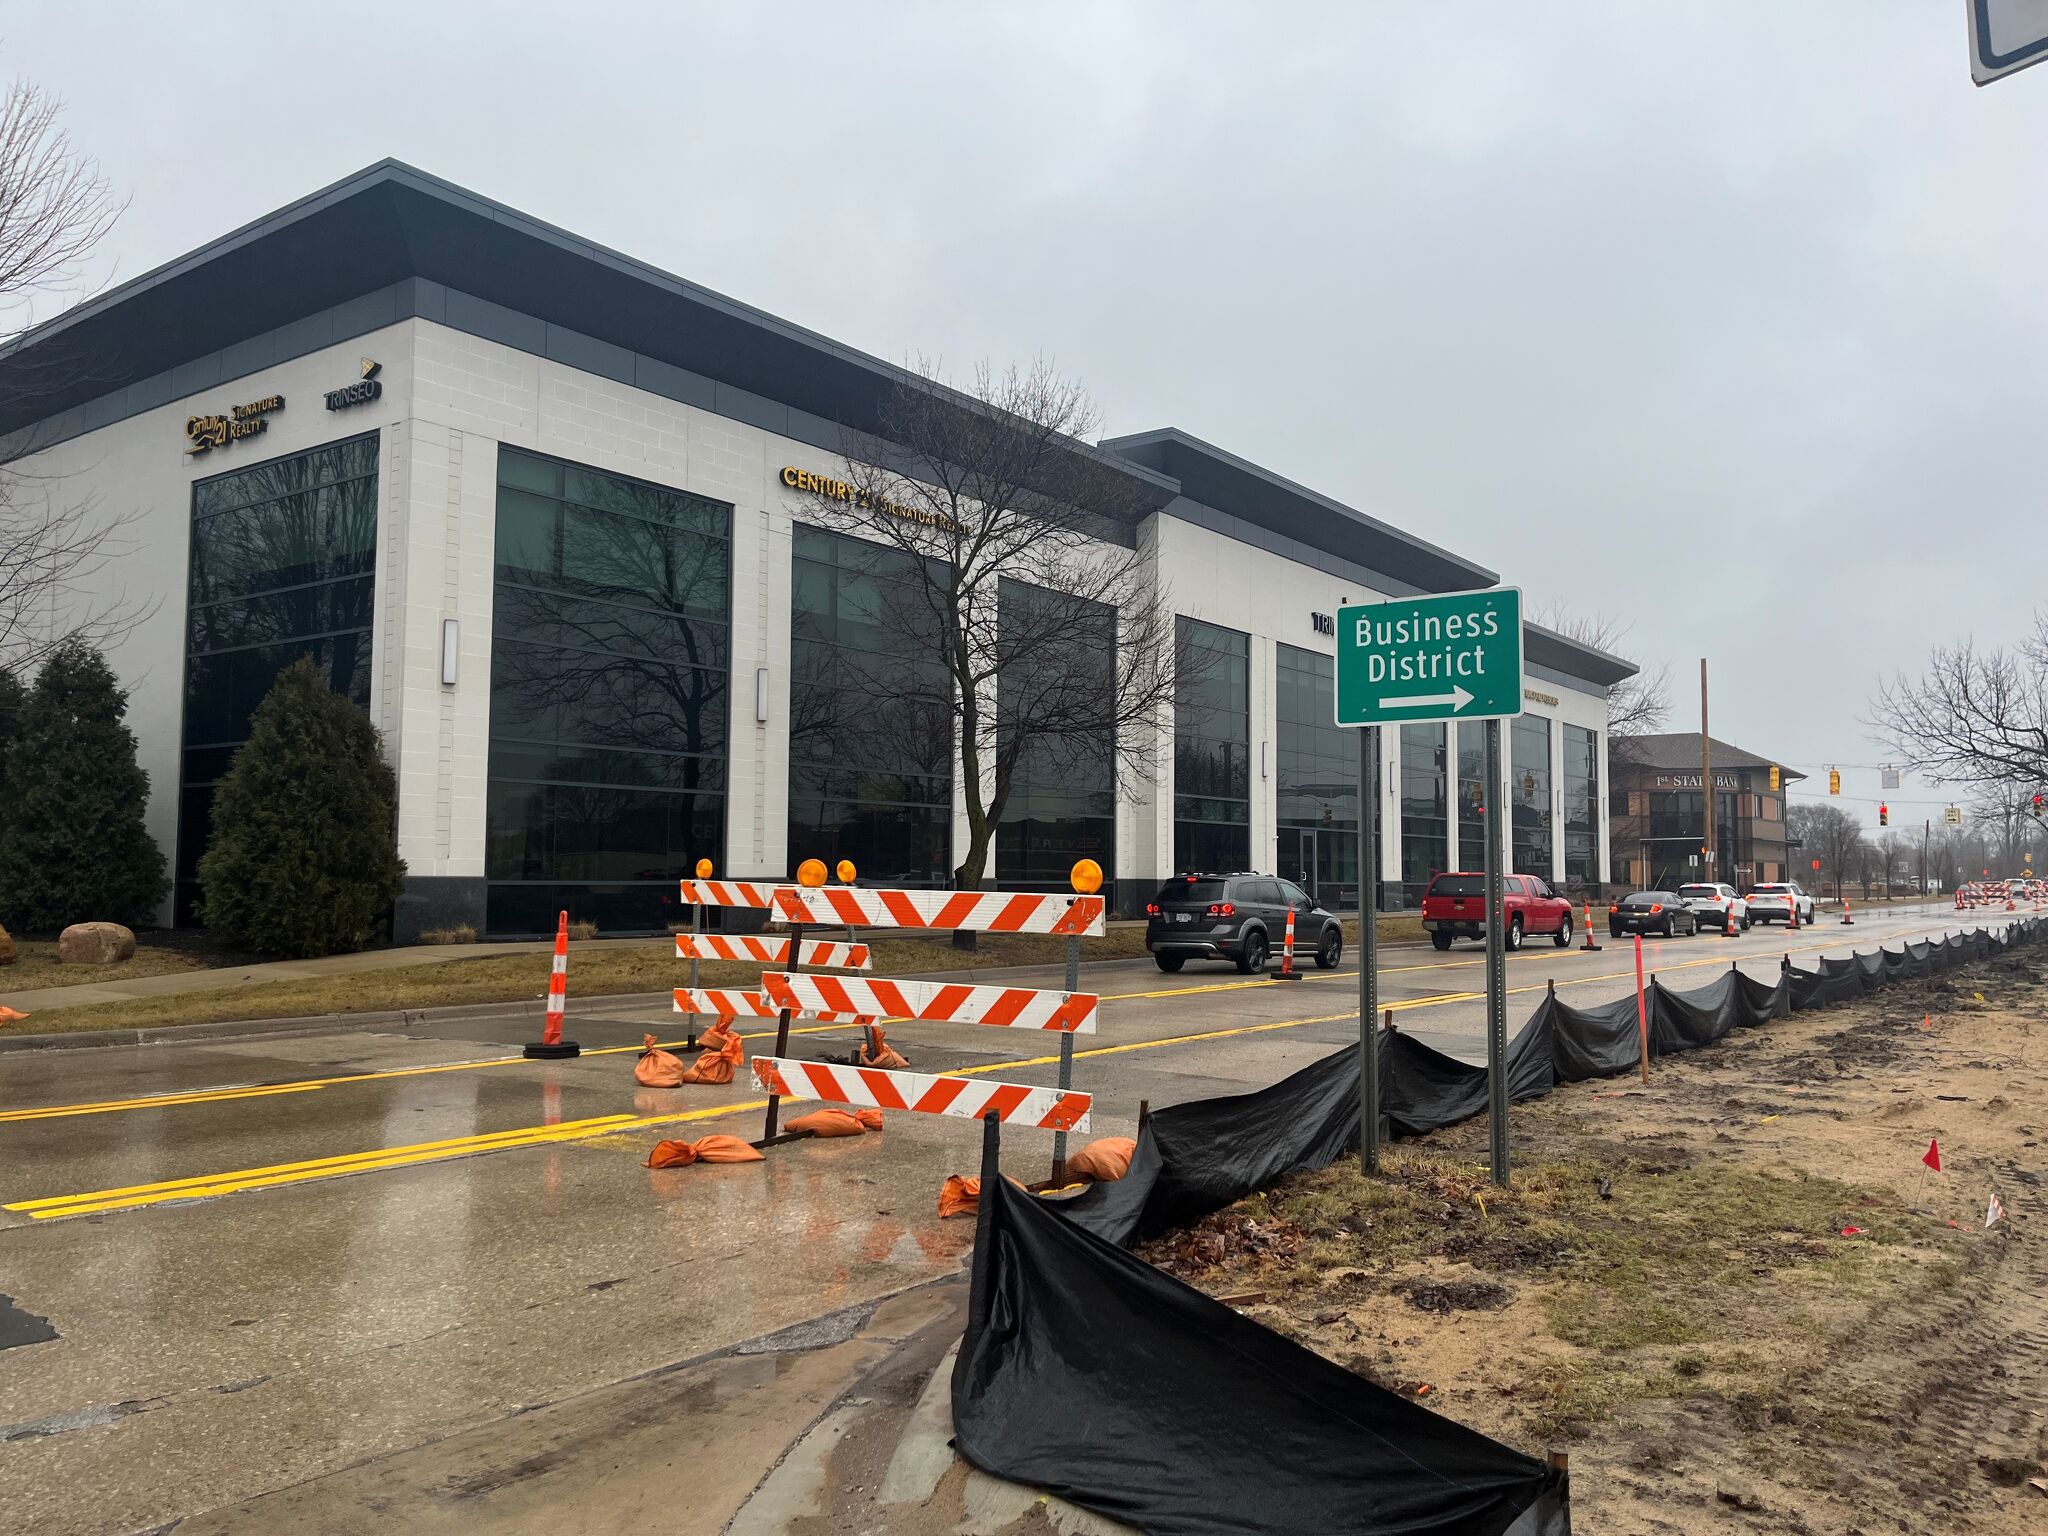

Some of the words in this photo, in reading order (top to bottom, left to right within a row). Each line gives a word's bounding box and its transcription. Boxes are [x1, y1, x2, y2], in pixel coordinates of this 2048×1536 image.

[230, 396, 283, 420] SIGNATURE
[323, 379, 381, 411] TRINSEO
[215, 420, 230, 445] 21
[230, 420, 266, 439] REALTY
[780, 466, 854, 502] CENTURY
[1356, 611, 1498, 647] Business
[1369, 645, 1485, 682] District
[1673, 775, 1713, 788] STAT
